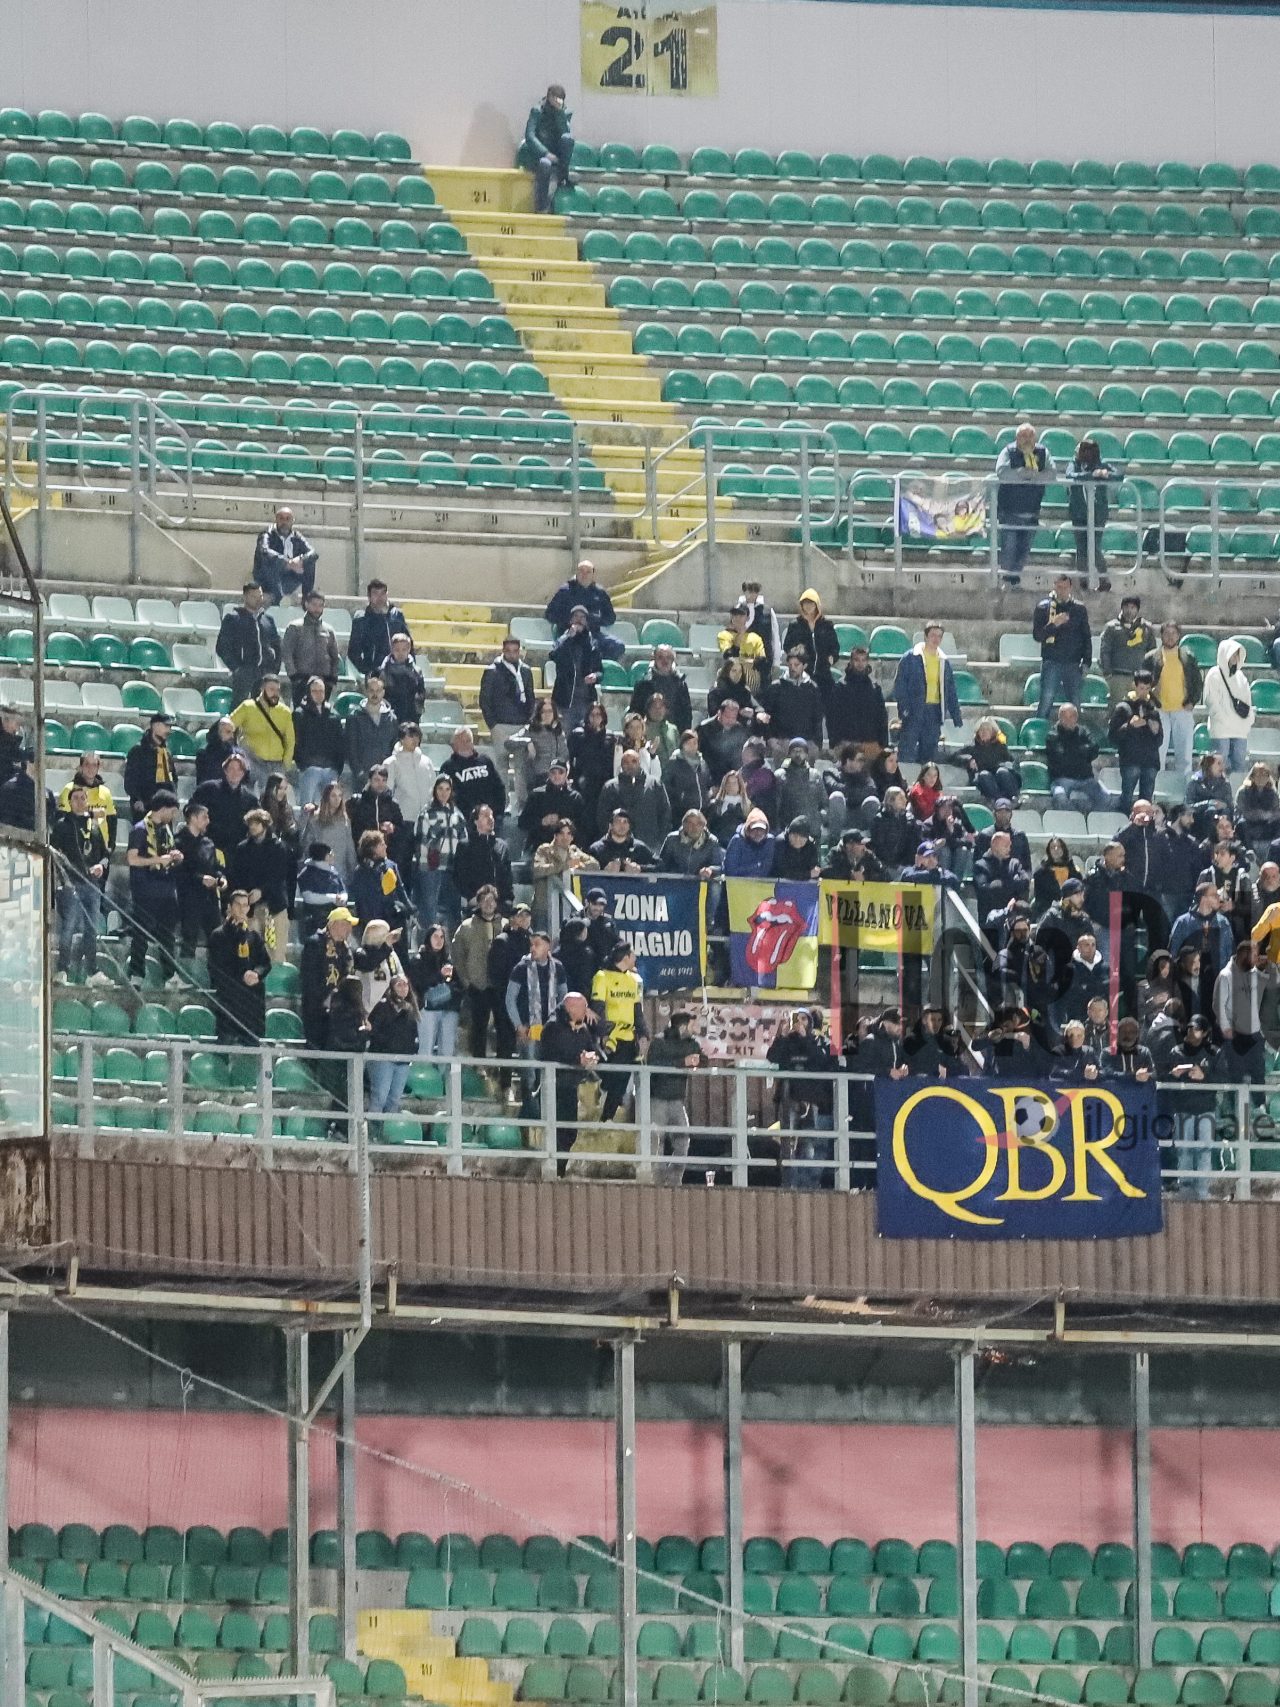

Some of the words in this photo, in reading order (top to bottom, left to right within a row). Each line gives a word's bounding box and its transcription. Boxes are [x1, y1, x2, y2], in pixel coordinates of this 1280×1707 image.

[600, 26, 688, 90] 21
[455, 765, 489, 783] VANS
[613, 893, 669, 922] ZONA
[825, 893, 930, 931] VILLANOVA
[726, 1045, 755, 1055] EXIT
[892, 1085, 1148, 1226] QBR
